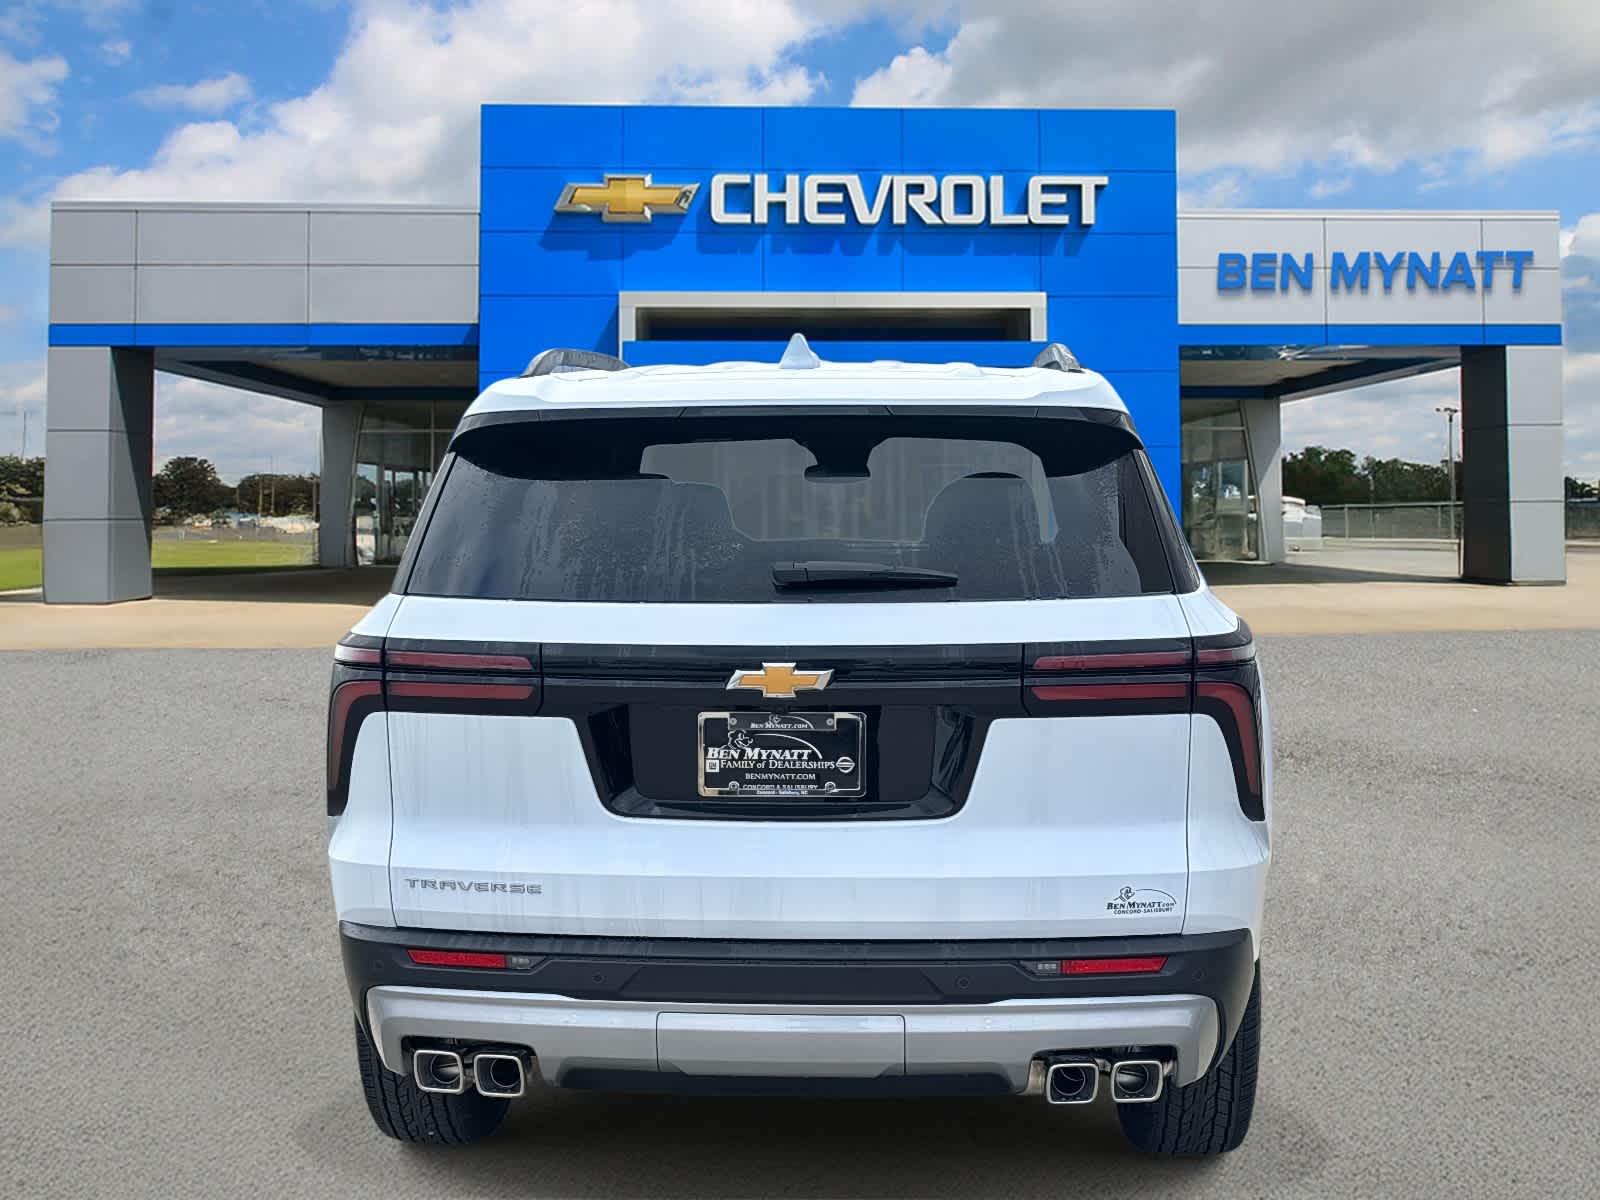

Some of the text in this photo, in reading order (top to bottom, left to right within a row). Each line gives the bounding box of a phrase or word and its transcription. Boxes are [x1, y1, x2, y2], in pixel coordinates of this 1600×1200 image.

[711, 174, 1109, 226] CHEVROLET
[1217, 251, 1534, 290] BEN MYNATT
[706, 748, 812, 760] BEN MYNATT
[768, 759, 836, 769] DEALERSHIPS
[745, 773, 816, 781] BENMYNATT.COM
[405, 878, 543, 894] TRAVERSE
[1107, 902, 1126, 910] BEN
